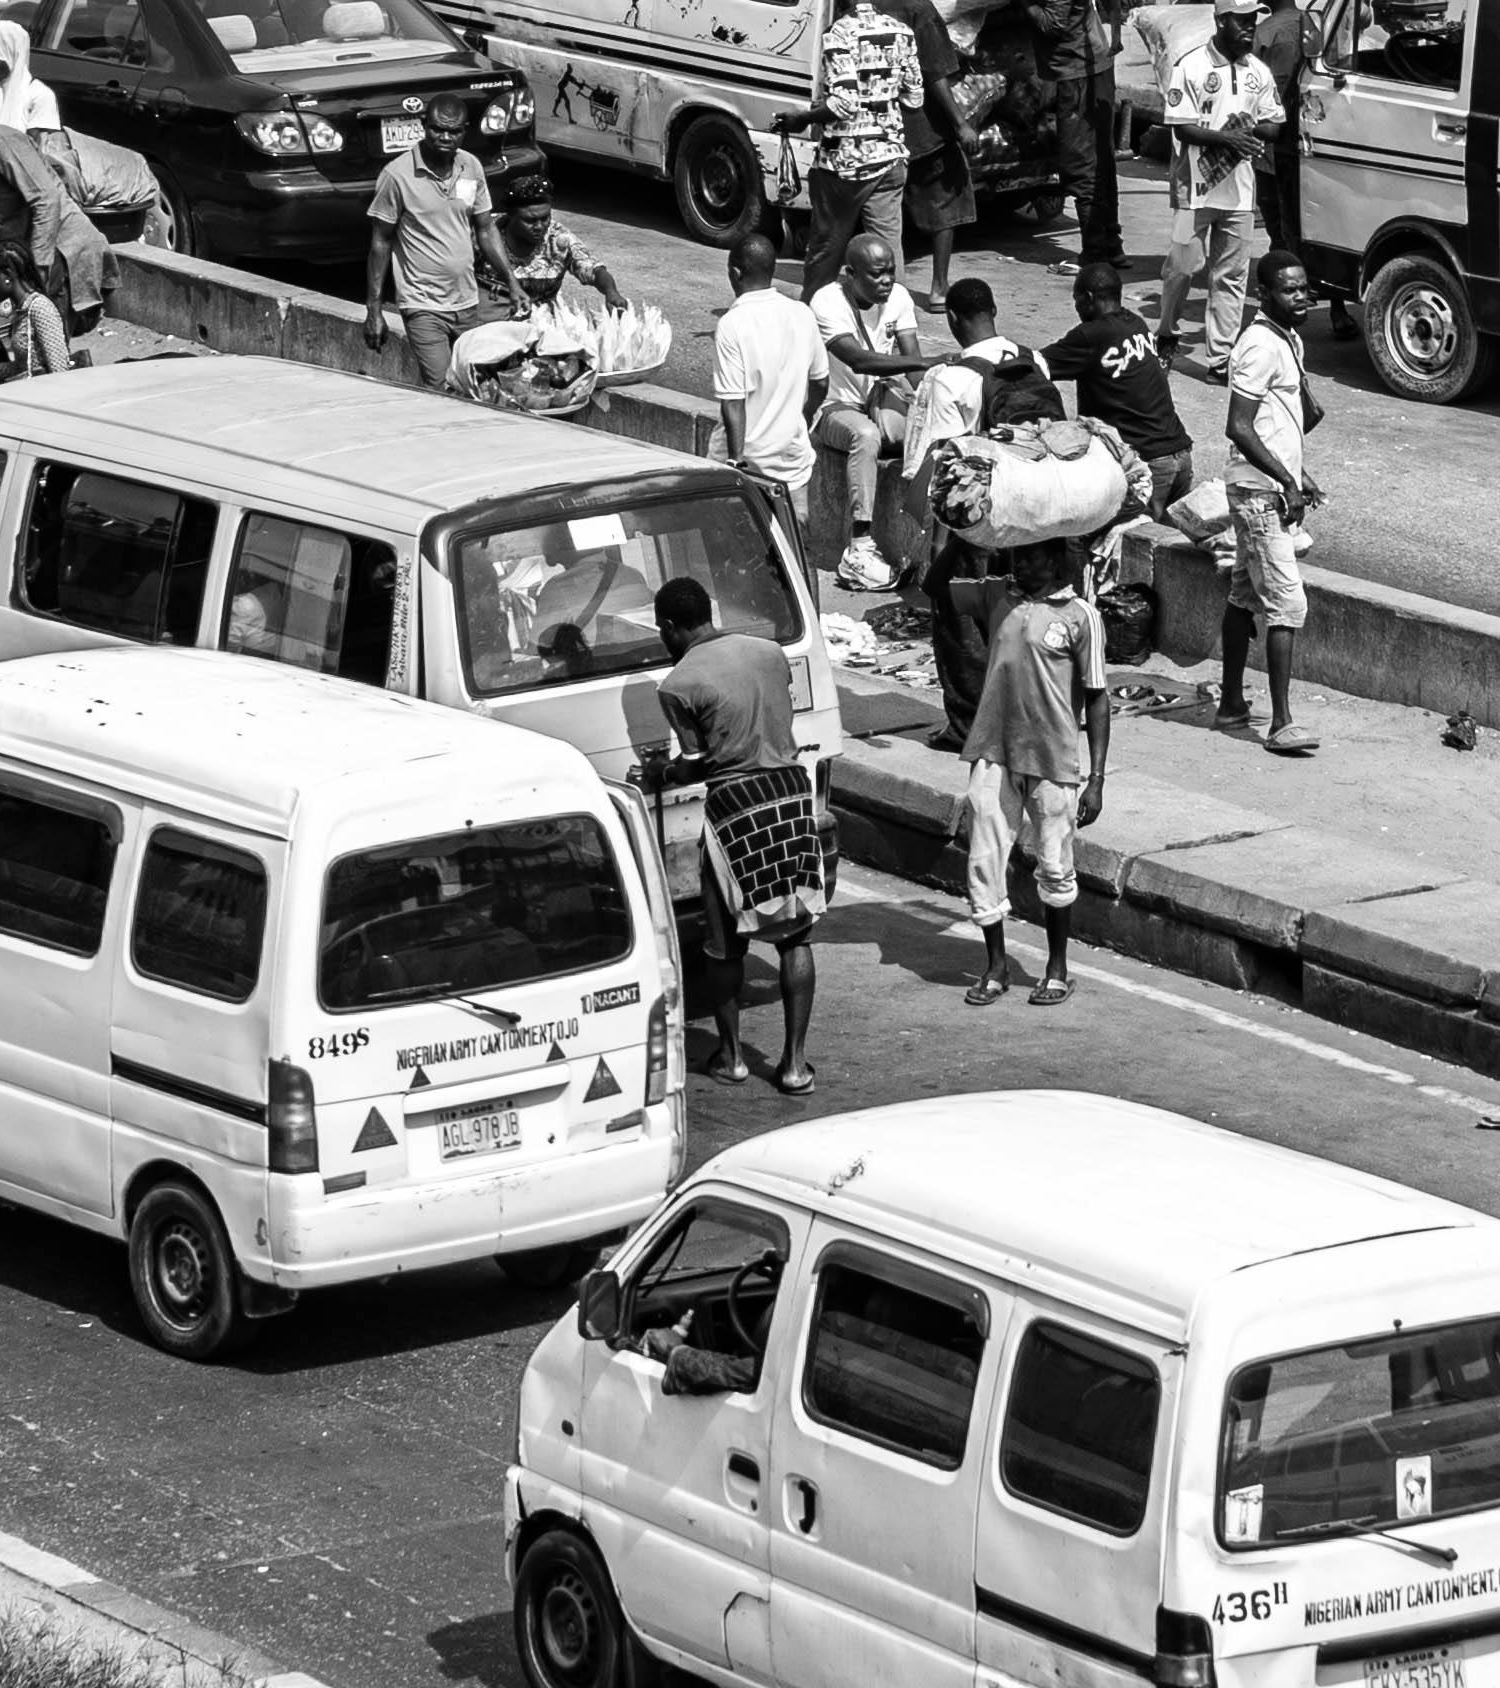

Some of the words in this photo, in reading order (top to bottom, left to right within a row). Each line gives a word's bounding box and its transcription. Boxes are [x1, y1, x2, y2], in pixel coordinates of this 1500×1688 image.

[581, 994, 594, 1014] 10
[397, 1043, 446, 1071] NIGERIAN
[448, 1037, 478, 1064] ARMY
[1304, 1593, 1362, 1627] NIGERIAN
[1366, 1587, 1402, 1614] ARMY
